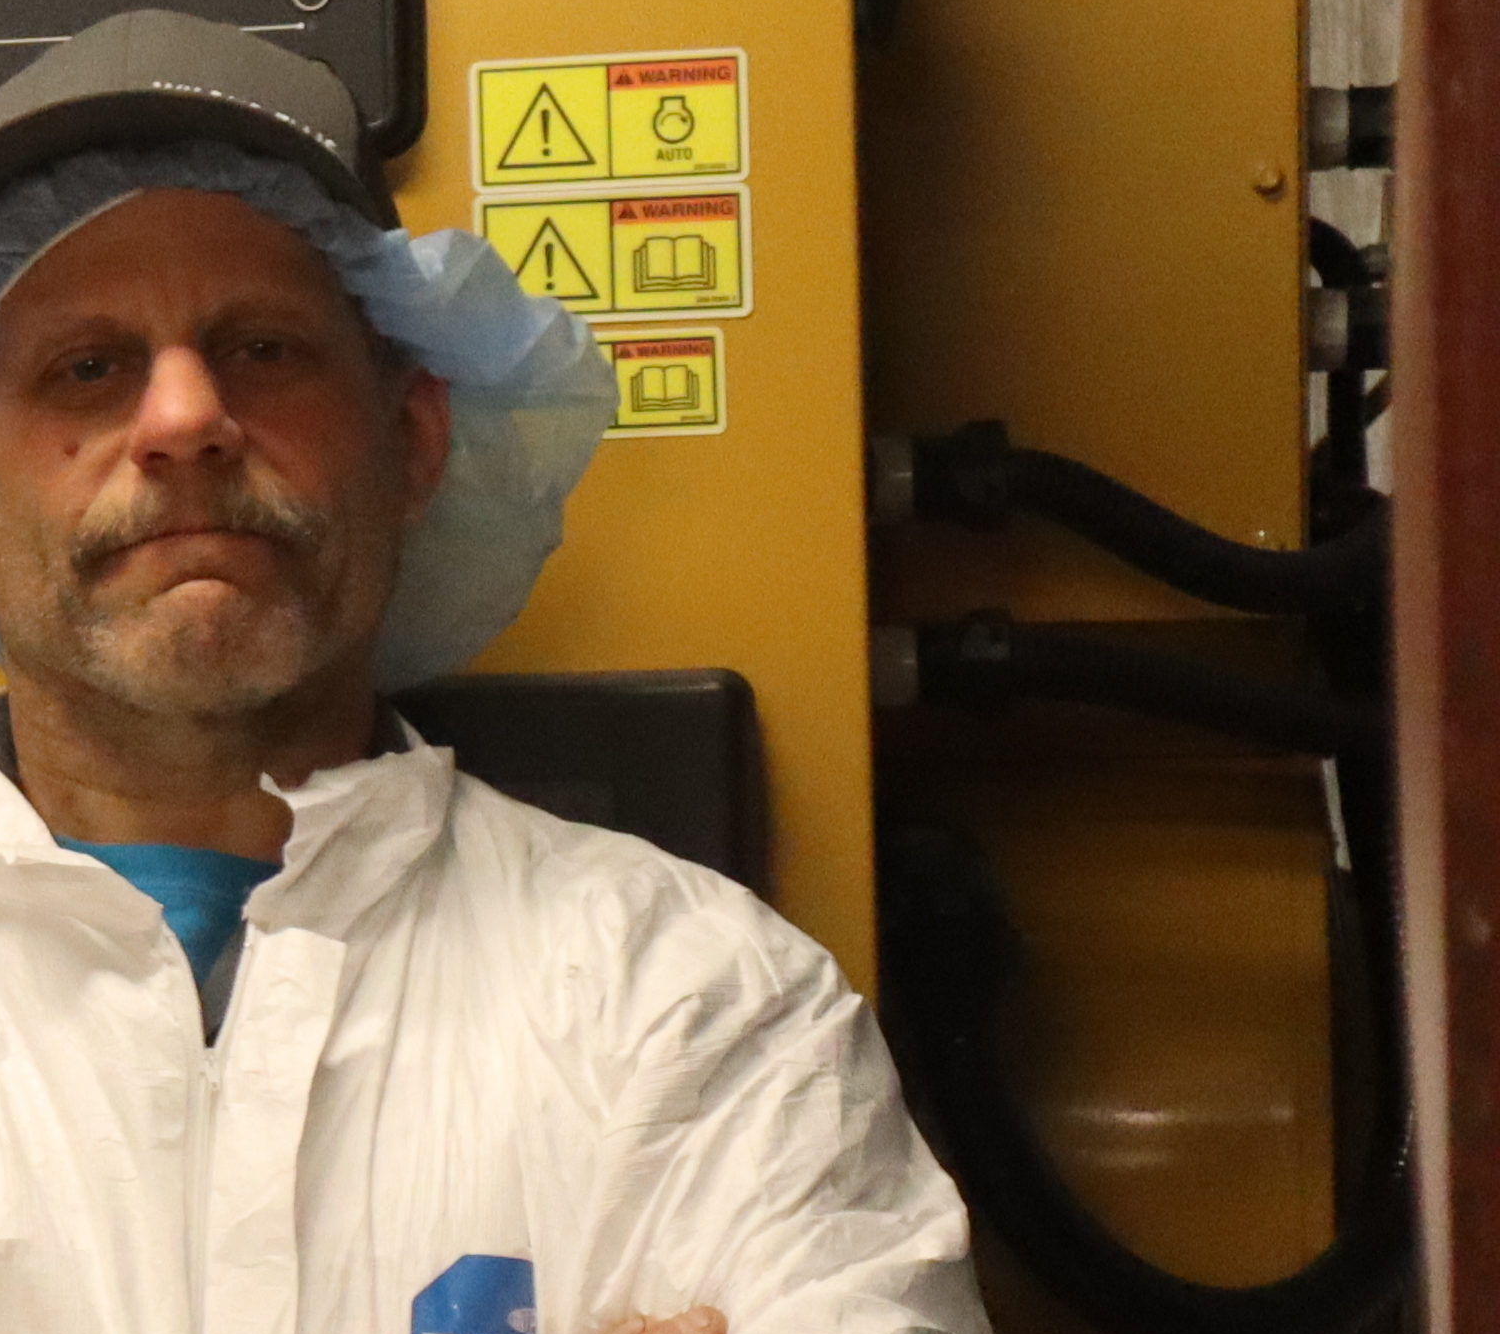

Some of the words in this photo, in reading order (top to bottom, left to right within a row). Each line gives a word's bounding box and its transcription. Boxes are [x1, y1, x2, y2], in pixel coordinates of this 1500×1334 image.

[639, 65, 731, 84] WARNING
[656, 147, 693, 161] AUTO
[642, 199, 734, 218] WARNING
[637, 341, 711, 357] WARNING
